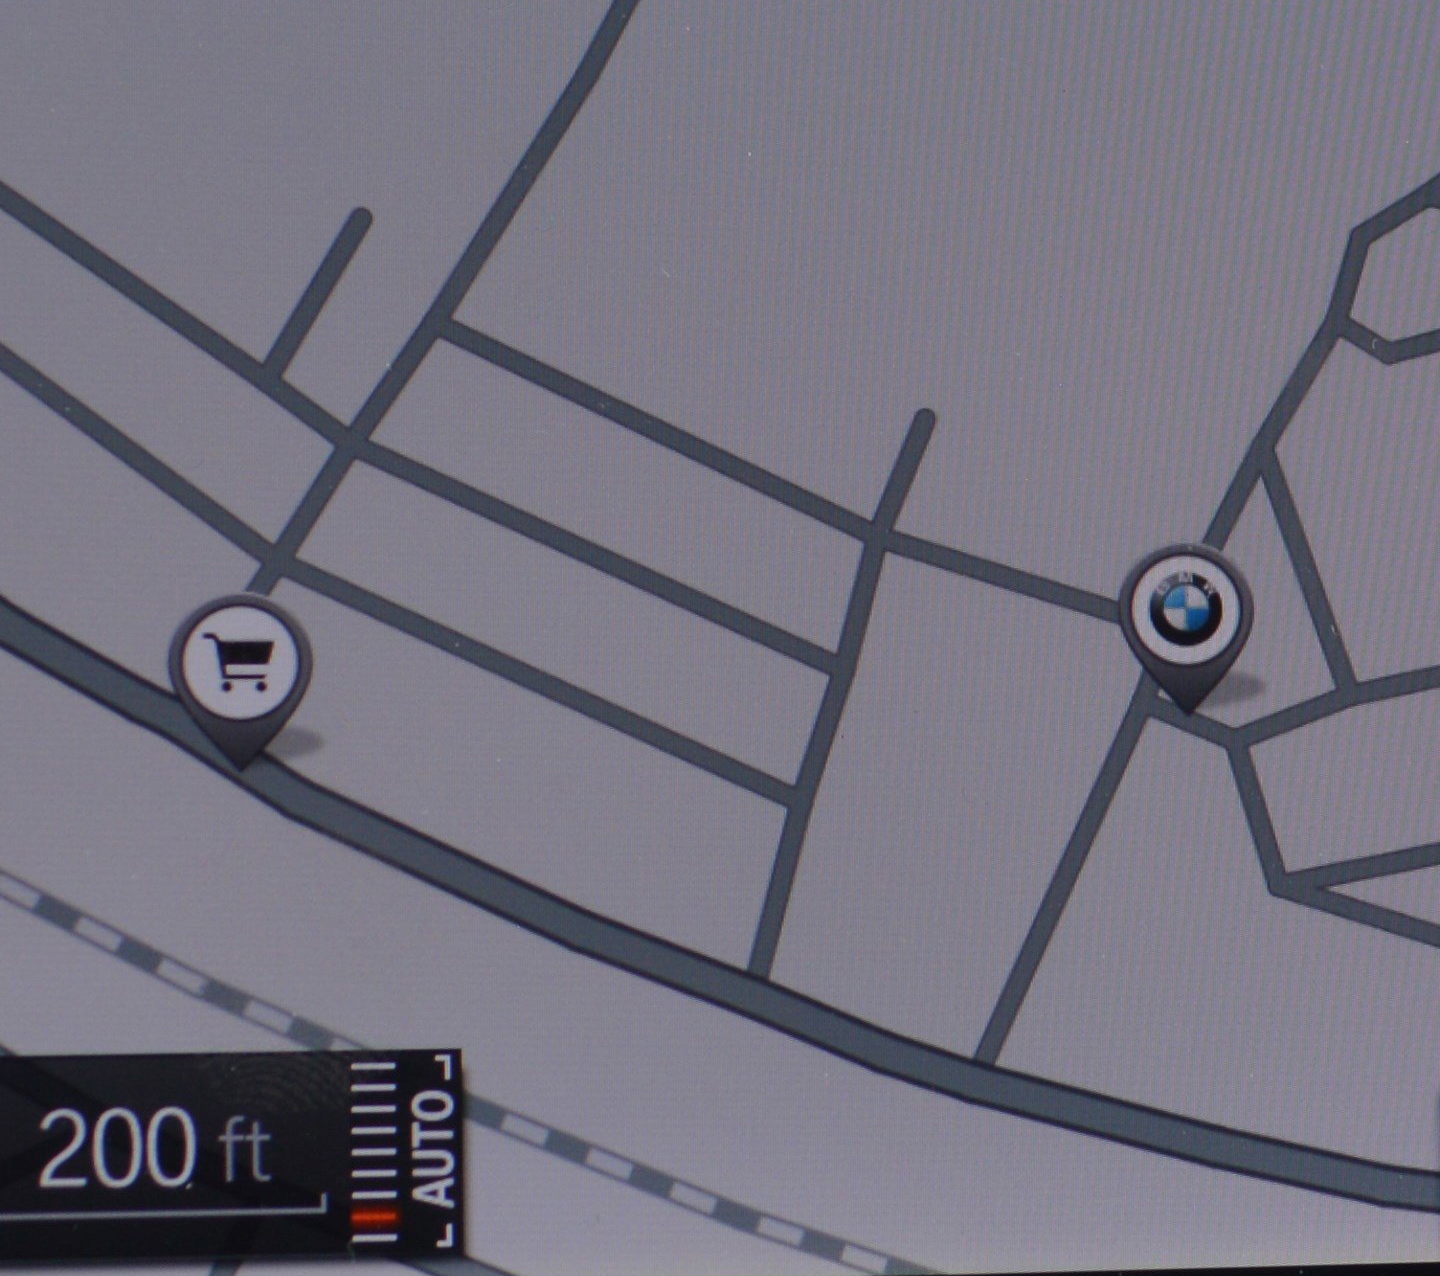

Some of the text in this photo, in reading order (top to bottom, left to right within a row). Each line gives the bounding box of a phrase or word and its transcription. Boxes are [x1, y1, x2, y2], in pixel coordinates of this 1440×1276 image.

[39, 1106, 272, 1188] 200 ft
[411, 1090, 455, 1207] AUTO
